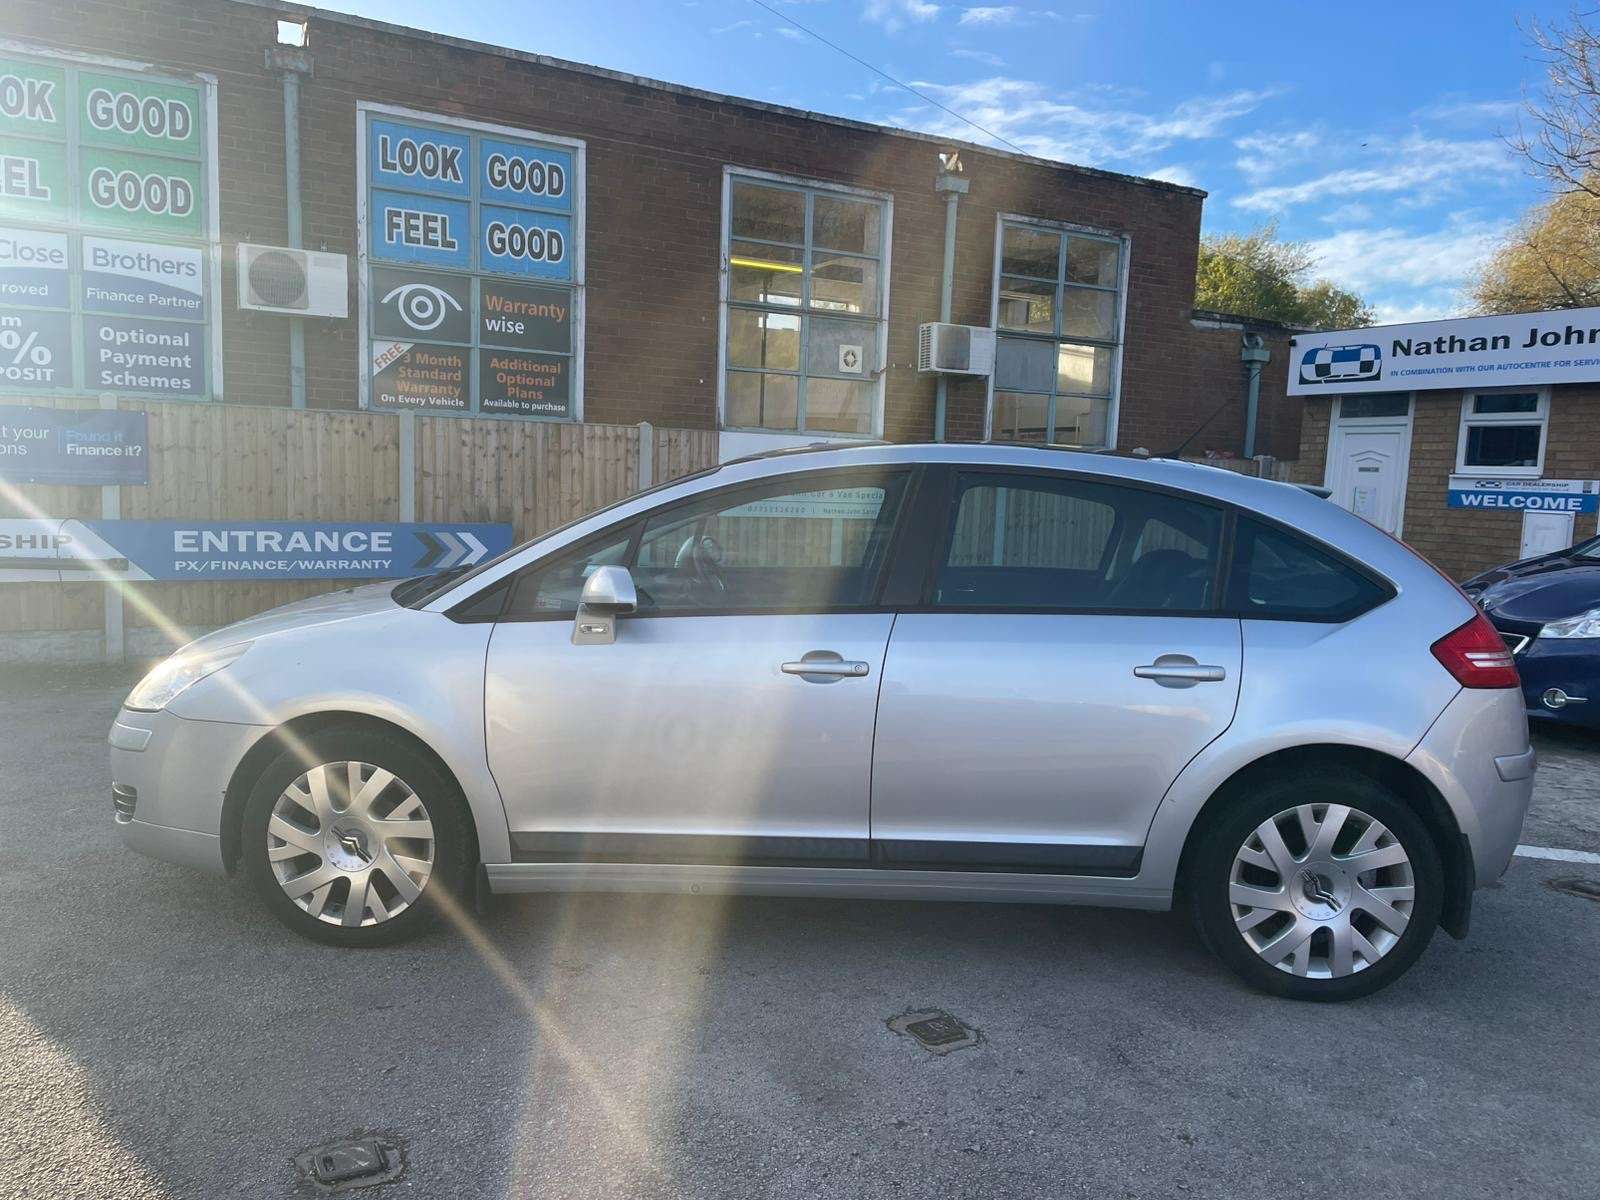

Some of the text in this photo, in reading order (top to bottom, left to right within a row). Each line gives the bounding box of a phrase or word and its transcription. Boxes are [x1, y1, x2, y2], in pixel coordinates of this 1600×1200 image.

[87, 88, 192, 140] GOOD
[379, 135, 566, 197] LOOK GOOD
[0, 155, 193, 217] EL GOOD
[385, 207, 565, 263] FEEL GOOD
[92, 247, 197, 277] Brothers
[86, 287, 144, 304] Finance
[149, 294, 201, 309] Partner
[486, 295, 566, 323] Warranty
[486, 316, 525, 335] wise
[100, 326, 190, 347] Optional
[1391, 334, 1511, 358] Nathan
[100, 349, 192, 369] Payment
[374, 342, 404, 369] FREE
[403, 352, 462, 368] 3 Month
[399, 366, 462, 381] Standard
[490, 358, 561, 374] Additional
[1400, 367, 1454, 376] COMBINATION
[1455, 365, 1476, 373] WITH
[1477, 364, 1495, 372] OUR
[1496, 360, 1552, 370] AUTOCENTRE
[1553, 360, 1571, 368] FOR
[101, 371, 191, 389] Schemes
[496, 372, 555, 387] Optional
[397, 381, 460, 398] Warranty
[507, 386, 544, 400] Plans
[381, 394, 465, 407] On Every Vehicle
[484, 398, 566, 412] Available to purchase
[12, 427, 50, 441] your
[66, 444, 142, 456] Finance it?
[1460, 493, 1583, 511] WELCOME
[174, 530, 393, 553] ENTRANCE
[174, 559, 392, 572] PX/FINANCE/WARRANTY
